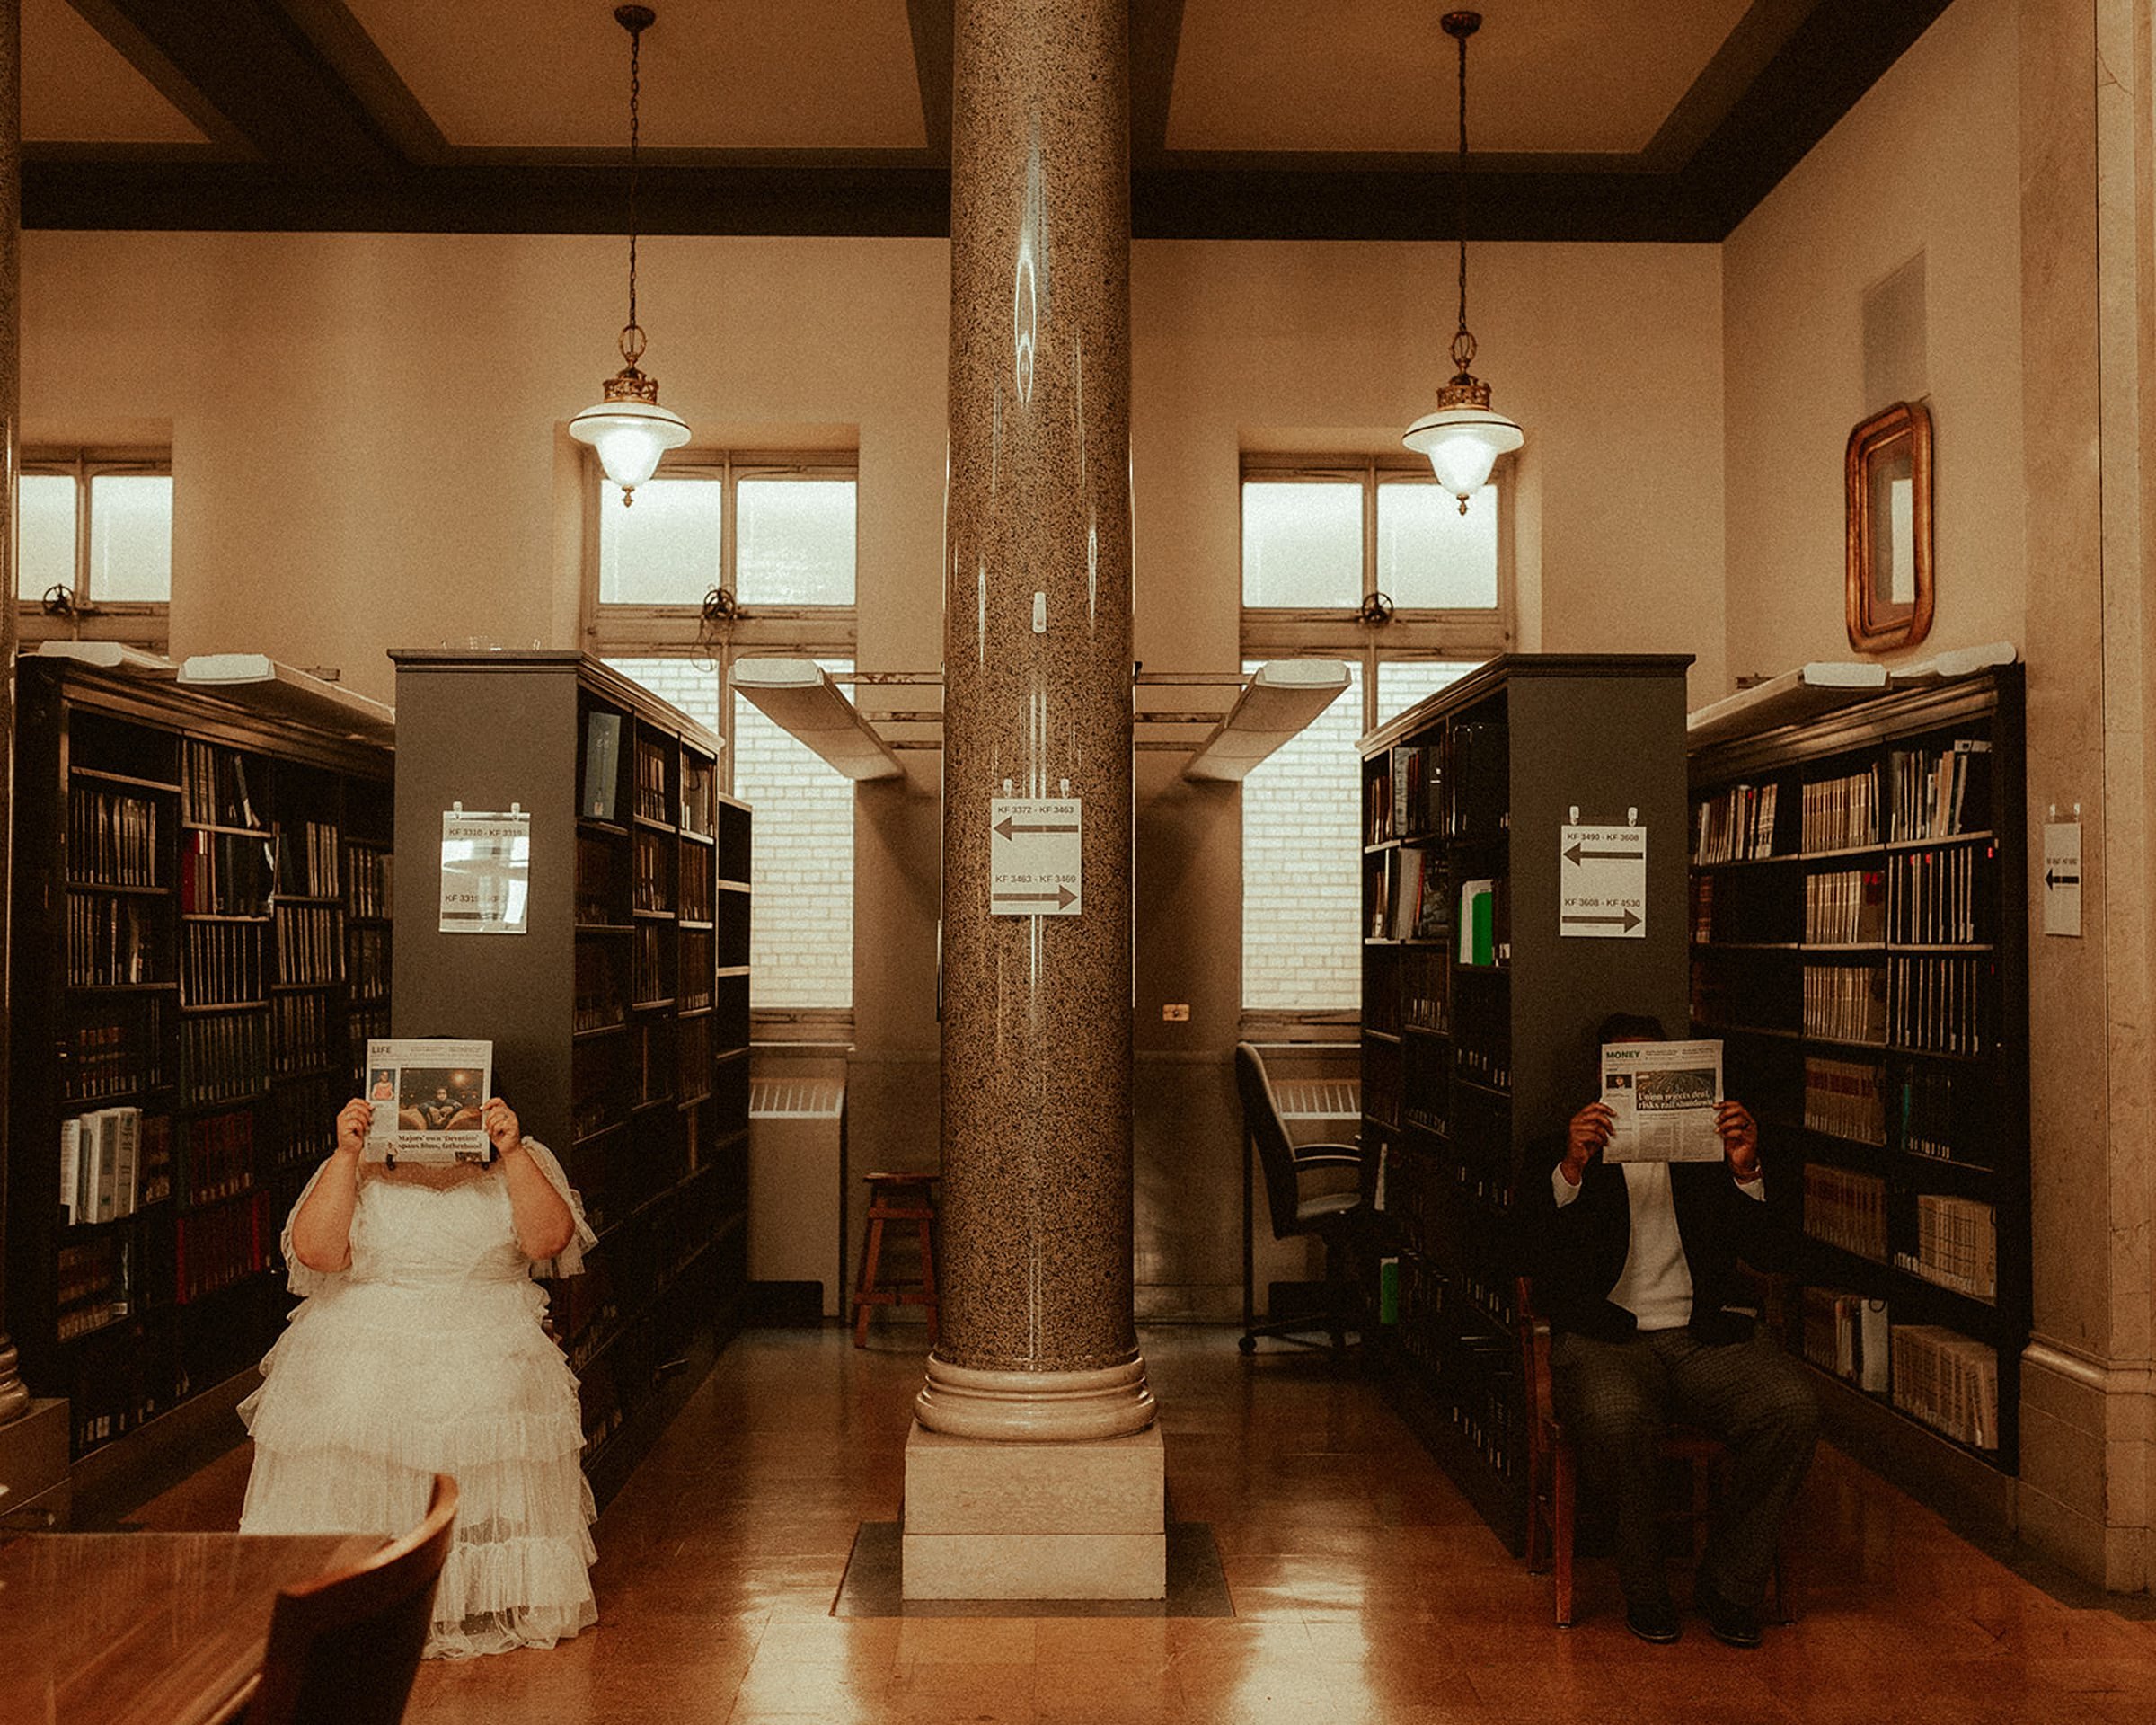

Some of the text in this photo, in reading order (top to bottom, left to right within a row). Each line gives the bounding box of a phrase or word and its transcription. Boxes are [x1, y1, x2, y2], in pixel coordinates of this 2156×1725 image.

[998, 806, 1009, 814] KF
[1039, 806, 1052, 814] KF
[1567, 833, 1578, 841] KF
[1606, 833, 1618, 841] KF
[995, 875, 1008, 883] KF
[1038, 875, 1053, 883] KF
[445, 894, 458, 902] KF
[1564, 898, 1577, 907] KF
[1606, 898, 1619, 907] KF
[371, 1046, 392, 1054] LIFE
[1605, 1050, 1640, 1059] MONEY
